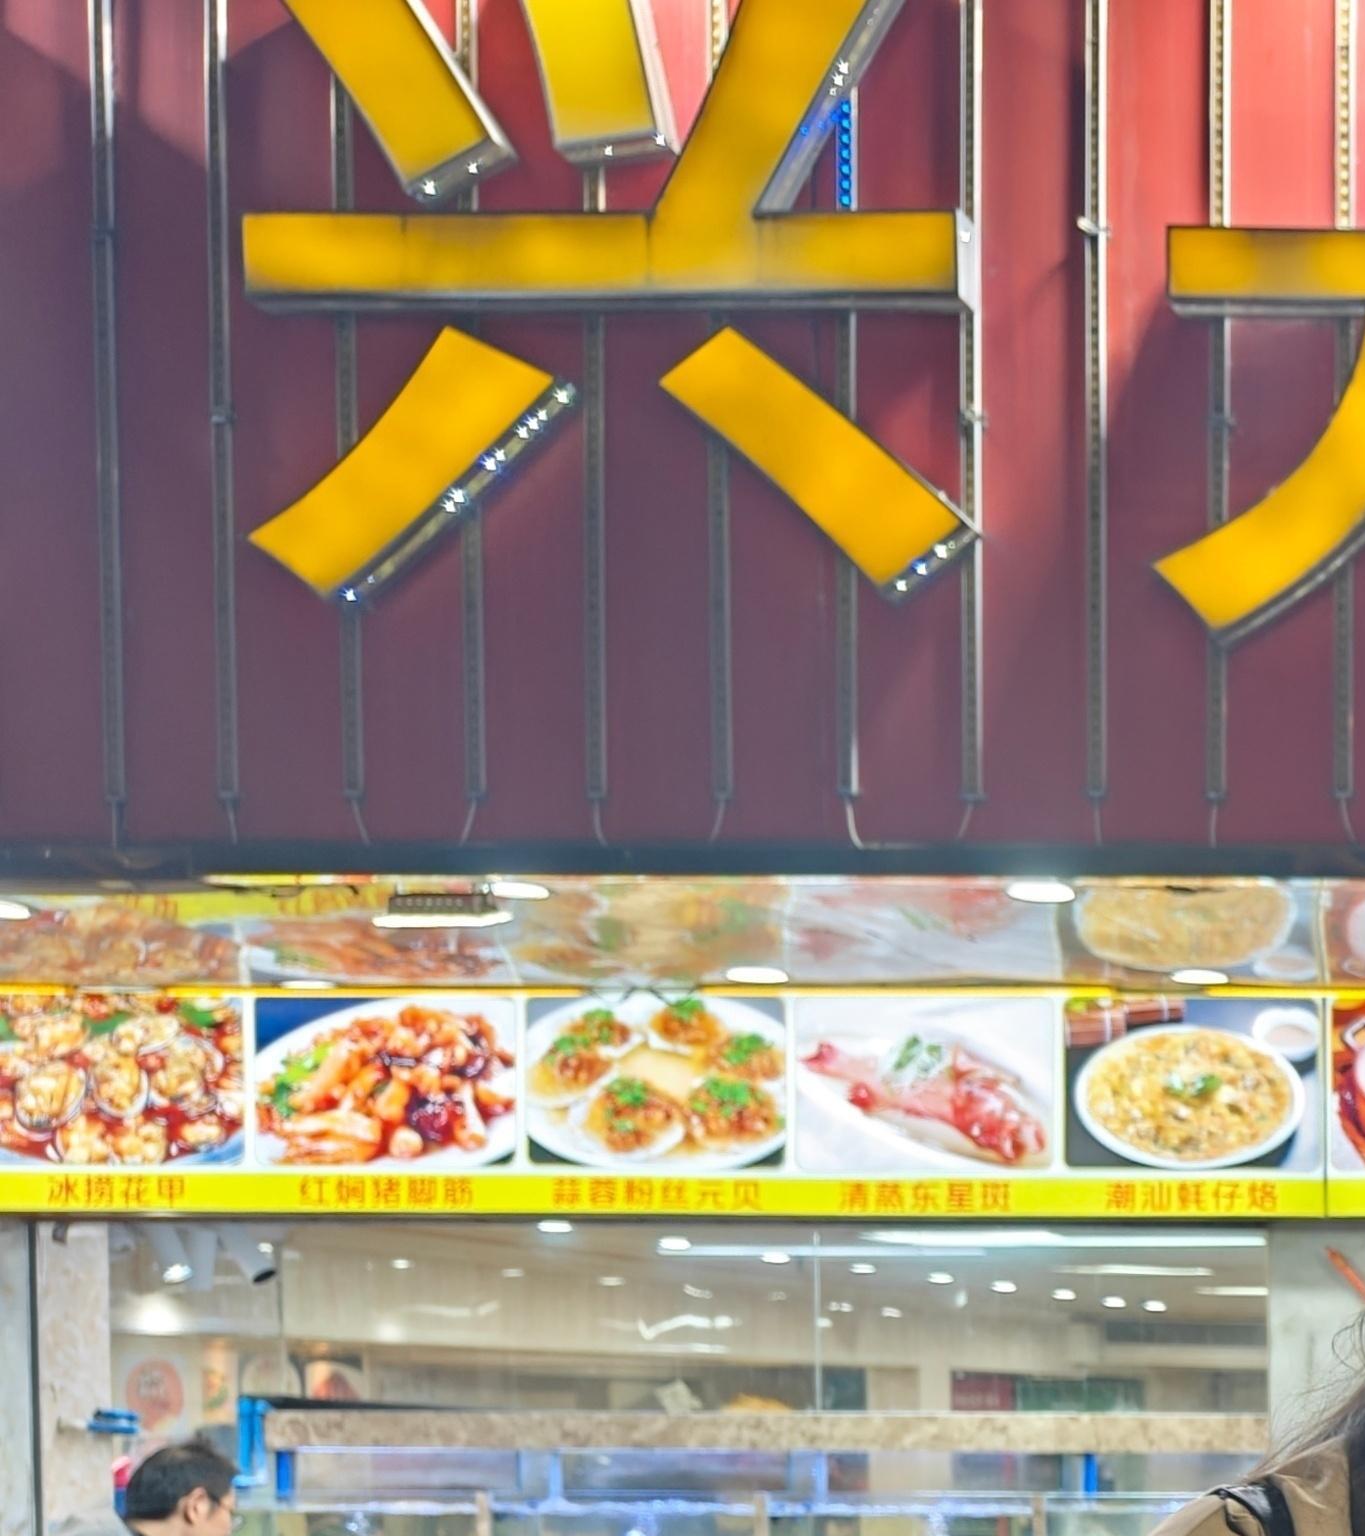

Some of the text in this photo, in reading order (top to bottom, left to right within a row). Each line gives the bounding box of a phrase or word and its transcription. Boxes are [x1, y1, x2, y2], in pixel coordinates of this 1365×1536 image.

[48, 1174, 185, 1207] 冰捞花甲
[299, 1175, 473, 1206] 红焖猪脚筋
[552, 1179, 764, 1211] 蒜蓉粉丝元贝
[839, 1181, 1011, 1212] 清蒸东星斑
[1104, 1179, 1278, 1212] 潮汕蚝仔烙
